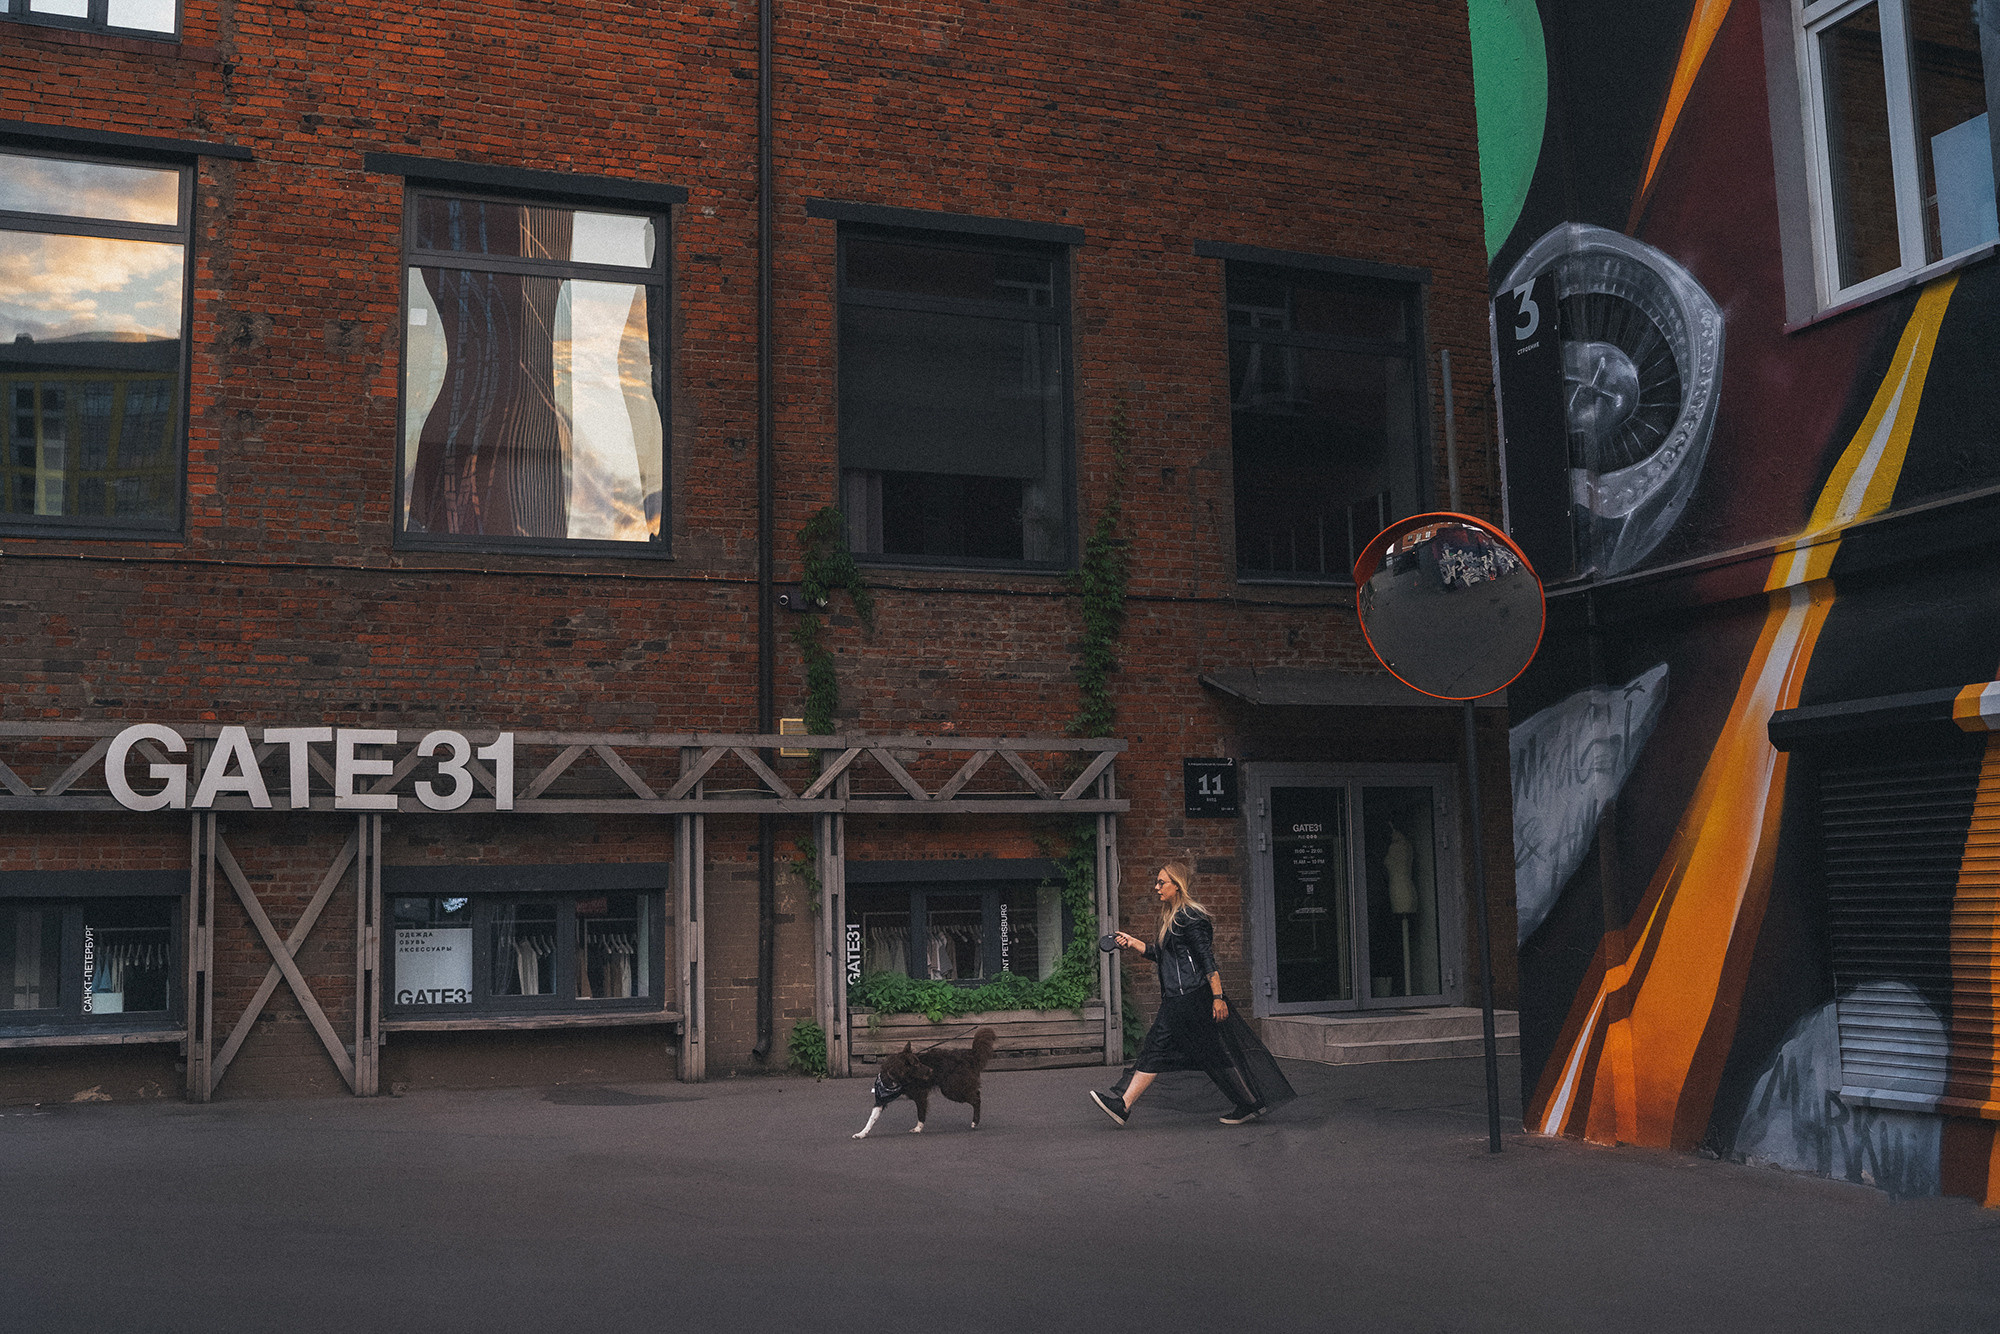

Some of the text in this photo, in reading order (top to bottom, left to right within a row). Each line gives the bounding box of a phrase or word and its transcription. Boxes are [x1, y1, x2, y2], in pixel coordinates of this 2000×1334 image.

[1513, 277, 1540, 341] 3
[104, 723, 515, 811] GATE 31
[1198, 773, 1225, 795] 11
[1227, 757, 1233, 766] 2
[1292, 823, 1323, 833] GATE31
[846, 924, 861, 986] GATE31
[1000, 903, 1009, 957] PETERSBURG
[83, 925, 94, 1012] САНКТ-ПЕТЕРБУРГ
